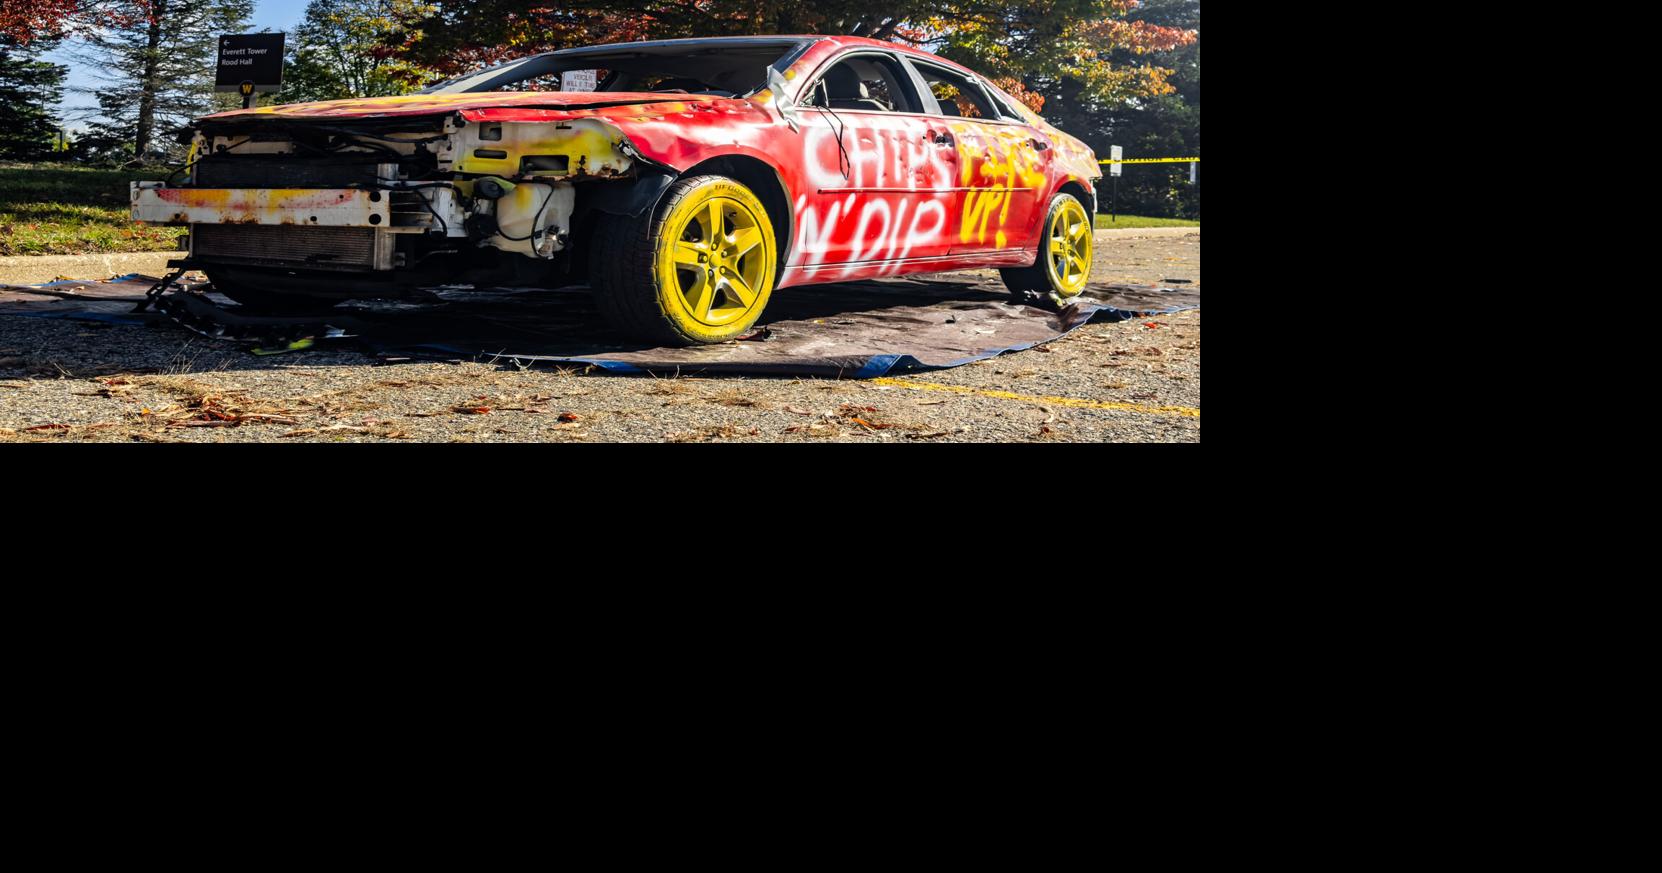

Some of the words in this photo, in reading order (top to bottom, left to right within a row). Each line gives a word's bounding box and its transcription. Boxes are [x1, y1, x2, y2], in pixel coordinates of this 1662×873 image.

[242, 84, 252, 93] W
[803, 115, 952, 197] CHIPS
[842, 198, 946, 277] DIP
